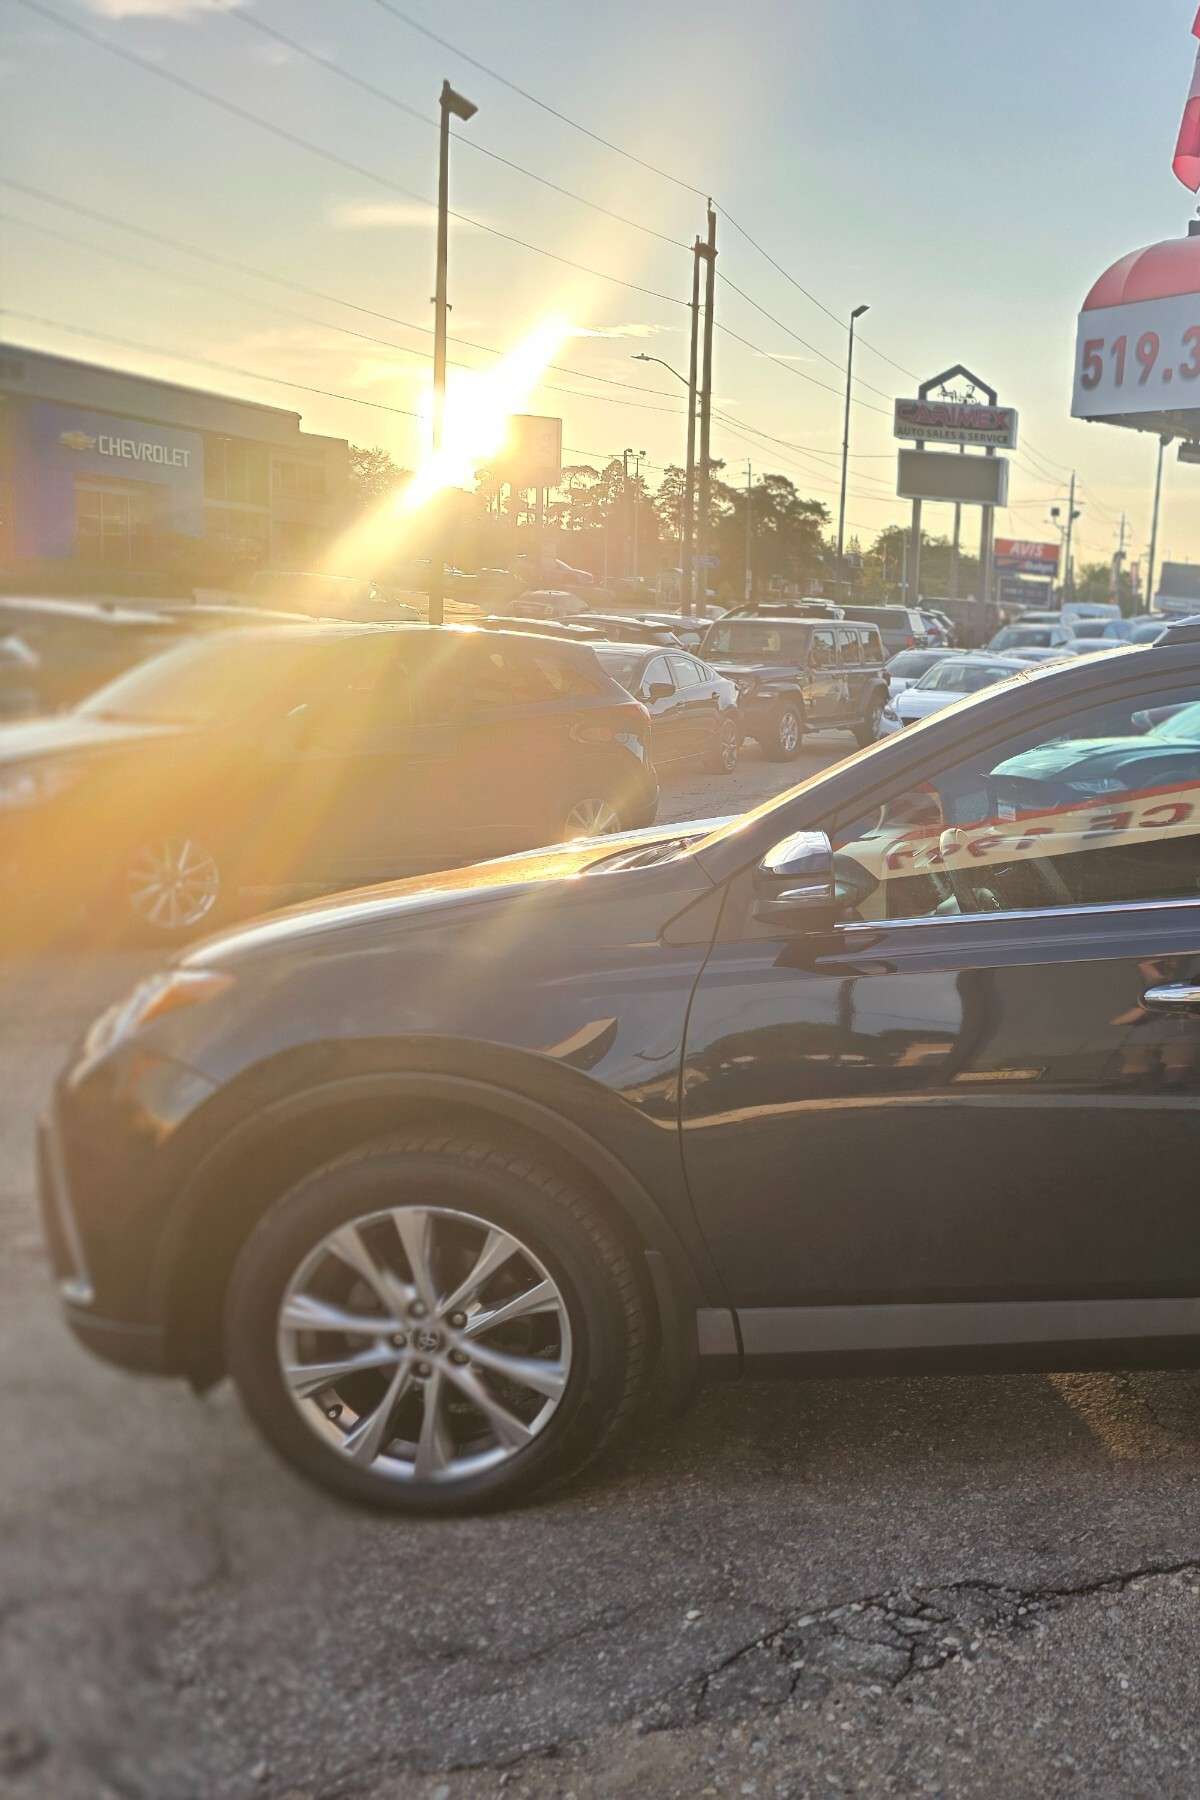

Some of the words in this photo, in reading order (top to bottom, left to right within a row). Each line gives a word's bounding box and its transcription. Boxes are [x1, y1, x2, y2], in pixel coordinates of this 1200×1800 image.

[897, 403, 1010, 431] CARIMEX
[897, 424, 924, 437] AUTO
[926, 428, 957, 440] SALES
[967, 431, 1009, 444] SERVICE
[99, 435, 192, 468] CHEVROLET
[1009, 542, 1043, 558] AVIS
